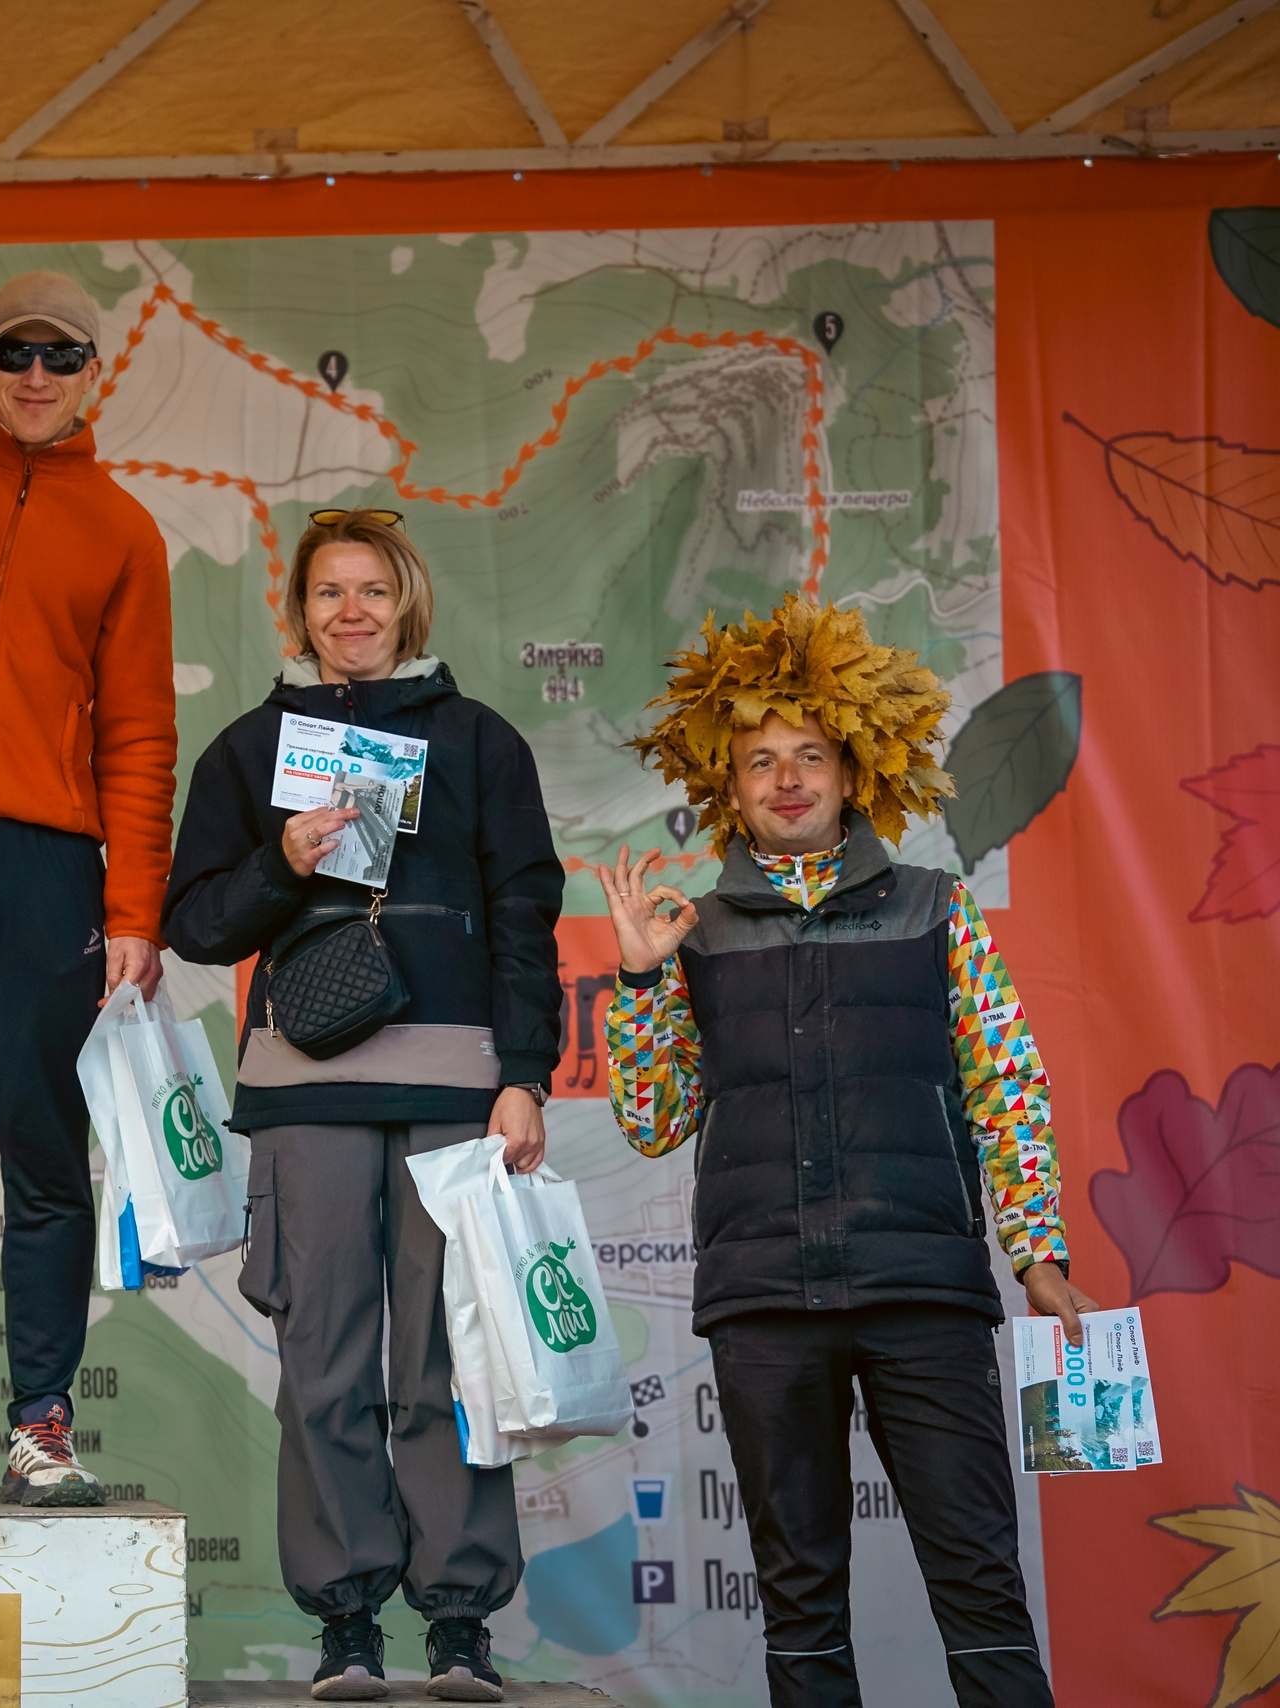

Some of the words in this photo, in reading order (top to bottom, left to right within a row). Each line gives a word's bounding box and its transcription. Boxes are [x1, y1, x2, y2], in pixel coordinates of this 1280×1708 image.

[823, 317, 837, 341] 5
[325, 355, 338, 378] 4
[522, 642, 604, 668] Змейка
[297, 720, 316, 728] Спорт
[318, 723, 335, 732] Лайф
[373, 784, 386, 814] КУПОН
[673, 814, 685, 833] 4
[835, 921, 871, 931] RedFox
[1114, 1332, 1123, 1352] Спорт
[1128, 1325, 1137, 1346] Спорт
[1116, 1353, 1124, 1372] Лайф
[1132, 1346, 1141, 1366] Лайф
[79, 1367, 118, 1399] ВОВ
